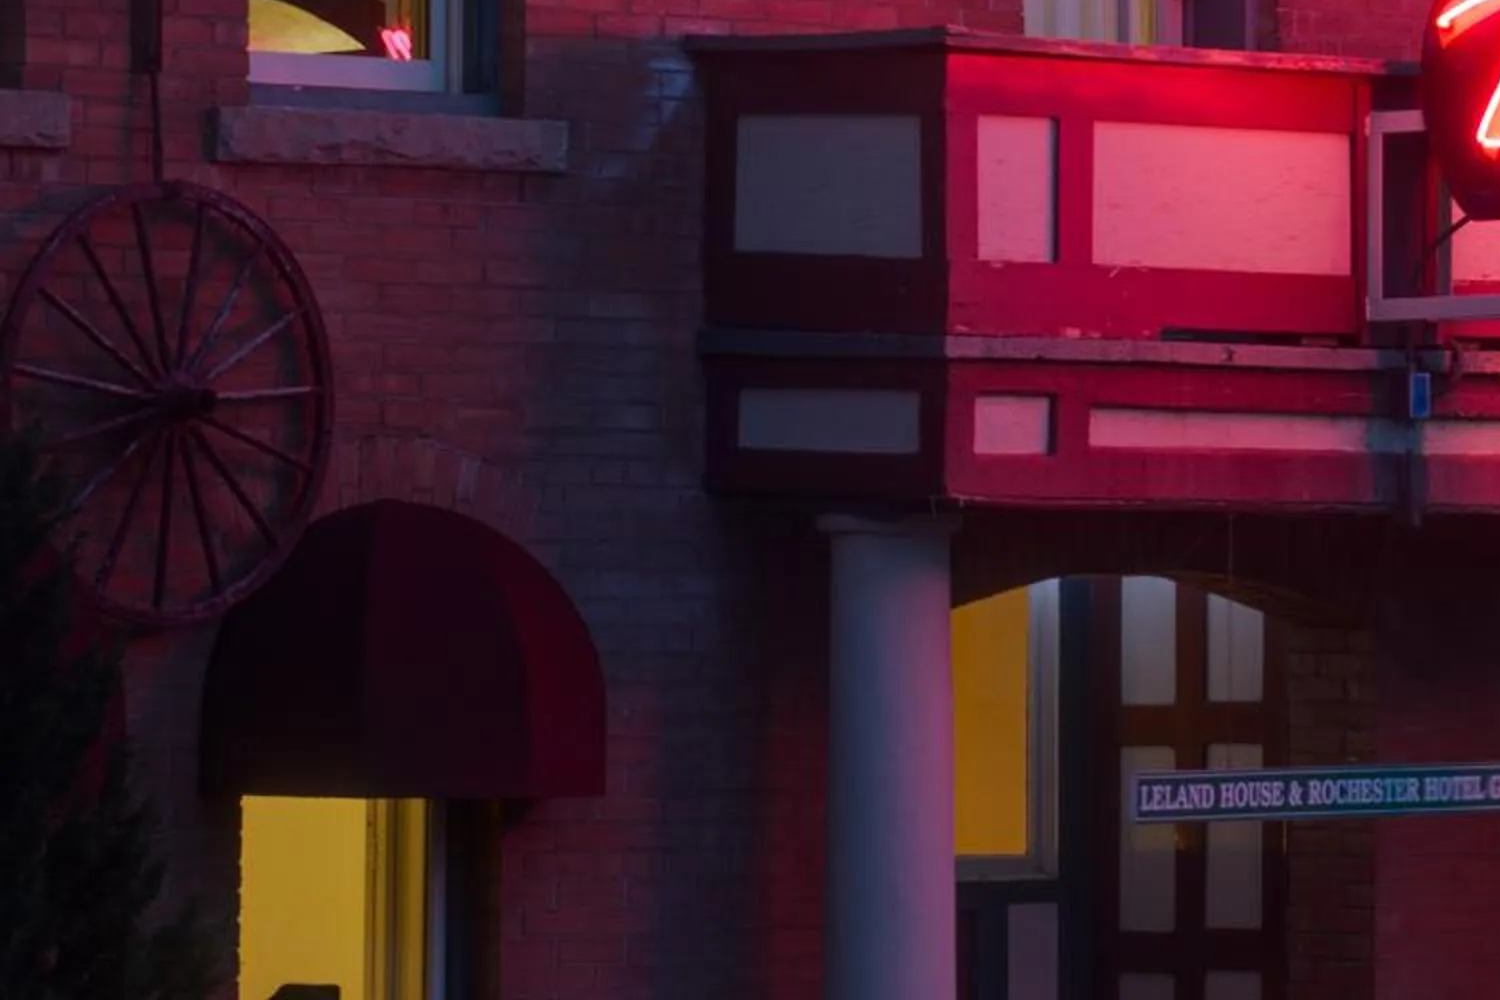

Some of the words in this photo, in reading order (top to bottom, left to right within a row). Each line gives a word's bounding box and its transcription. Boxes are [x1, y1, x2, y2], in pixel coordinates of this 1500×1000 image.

[1140, 784, 1215, 811] LELAND
[1220, 781, 1284, 808] HOUSE
[1288, 780, 1303, 806] &
[1308, 777, 1419, 805] ROCHESTER
[1423, 775, 1485, 802] HOTEL
